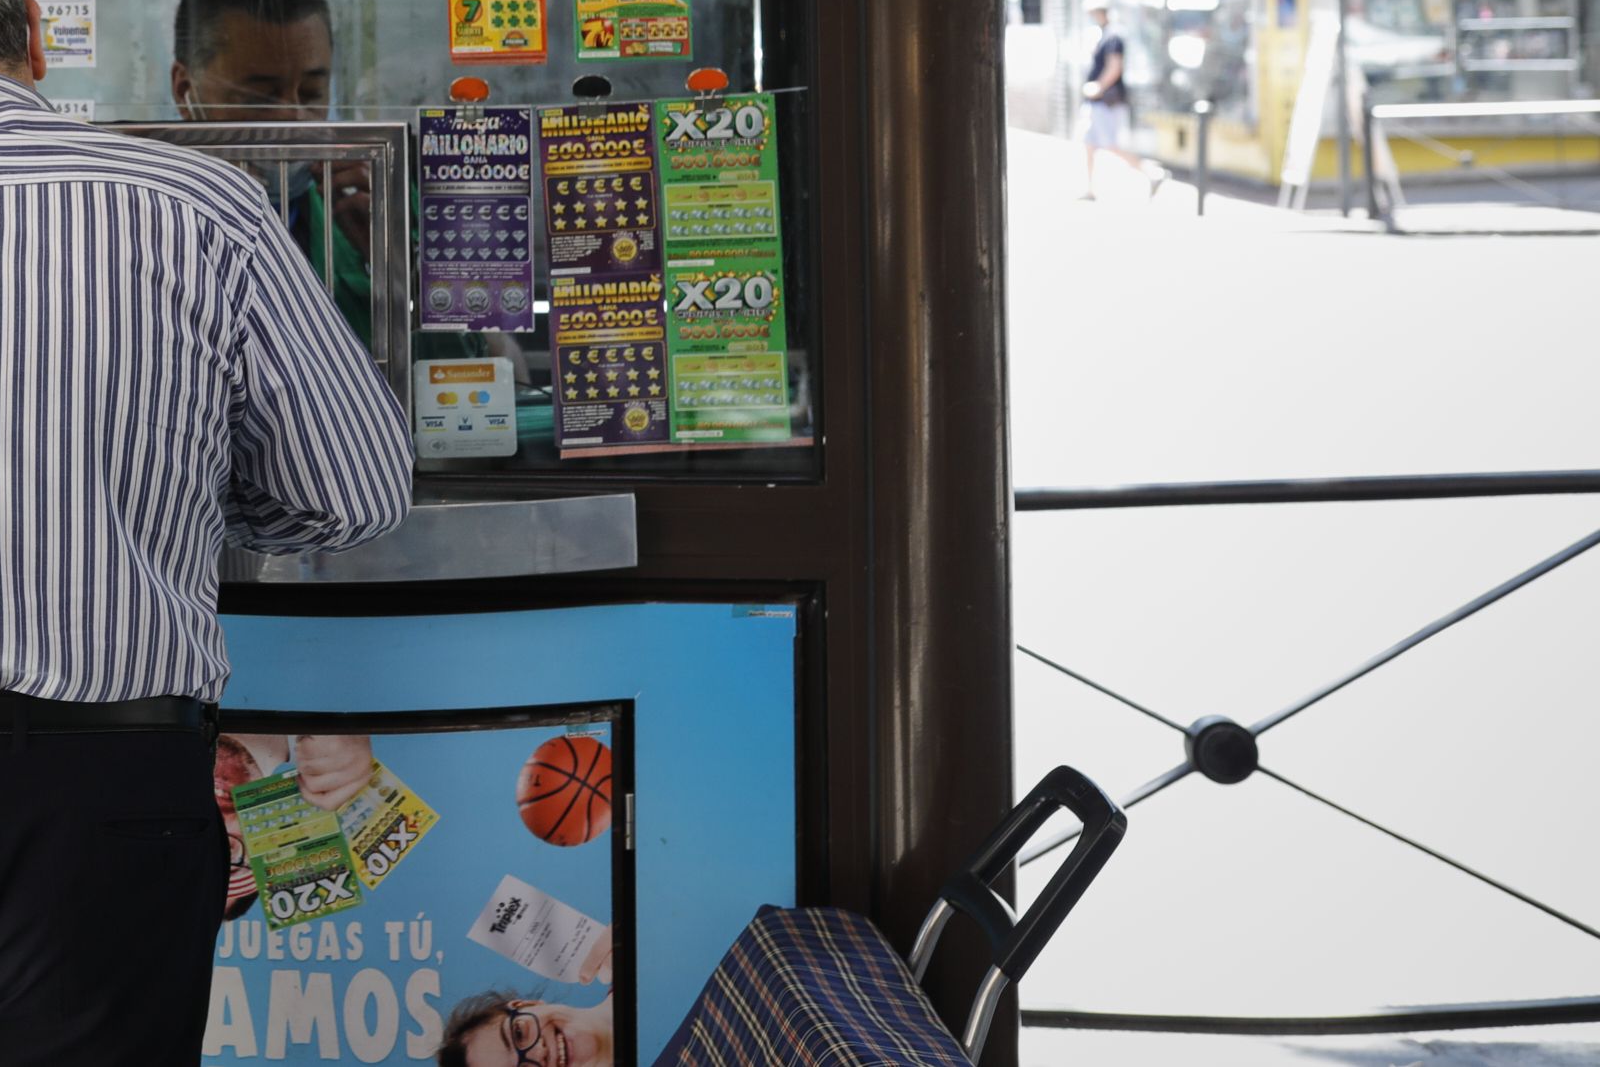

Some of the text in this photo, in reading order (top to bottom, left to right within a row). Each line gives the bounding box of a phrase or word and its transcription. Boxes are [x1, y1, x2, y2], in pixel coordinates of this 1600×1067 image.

[47, 5, 89, 15] 96715
[542, 112, 649, 138] MILLONARIO
[664, 105, 765, 142] X20
[421, 134, 529, 156] MILLONARIO
[547, 139, 647, 161] 500.000€
[423, 164, 530, 180] 1.000.000€
[553, 280, 661, 307] MILLONARIO
[673, 276, 774, 312] X20
[559, 309, 659, 330] 500.000€
[365, 819, 419, 876] X10
[271, 870, 354, 919] X20
[489, 897, 522, 934] Triplex
[218, 911, 444, 965] JUEGAS TÚ,
